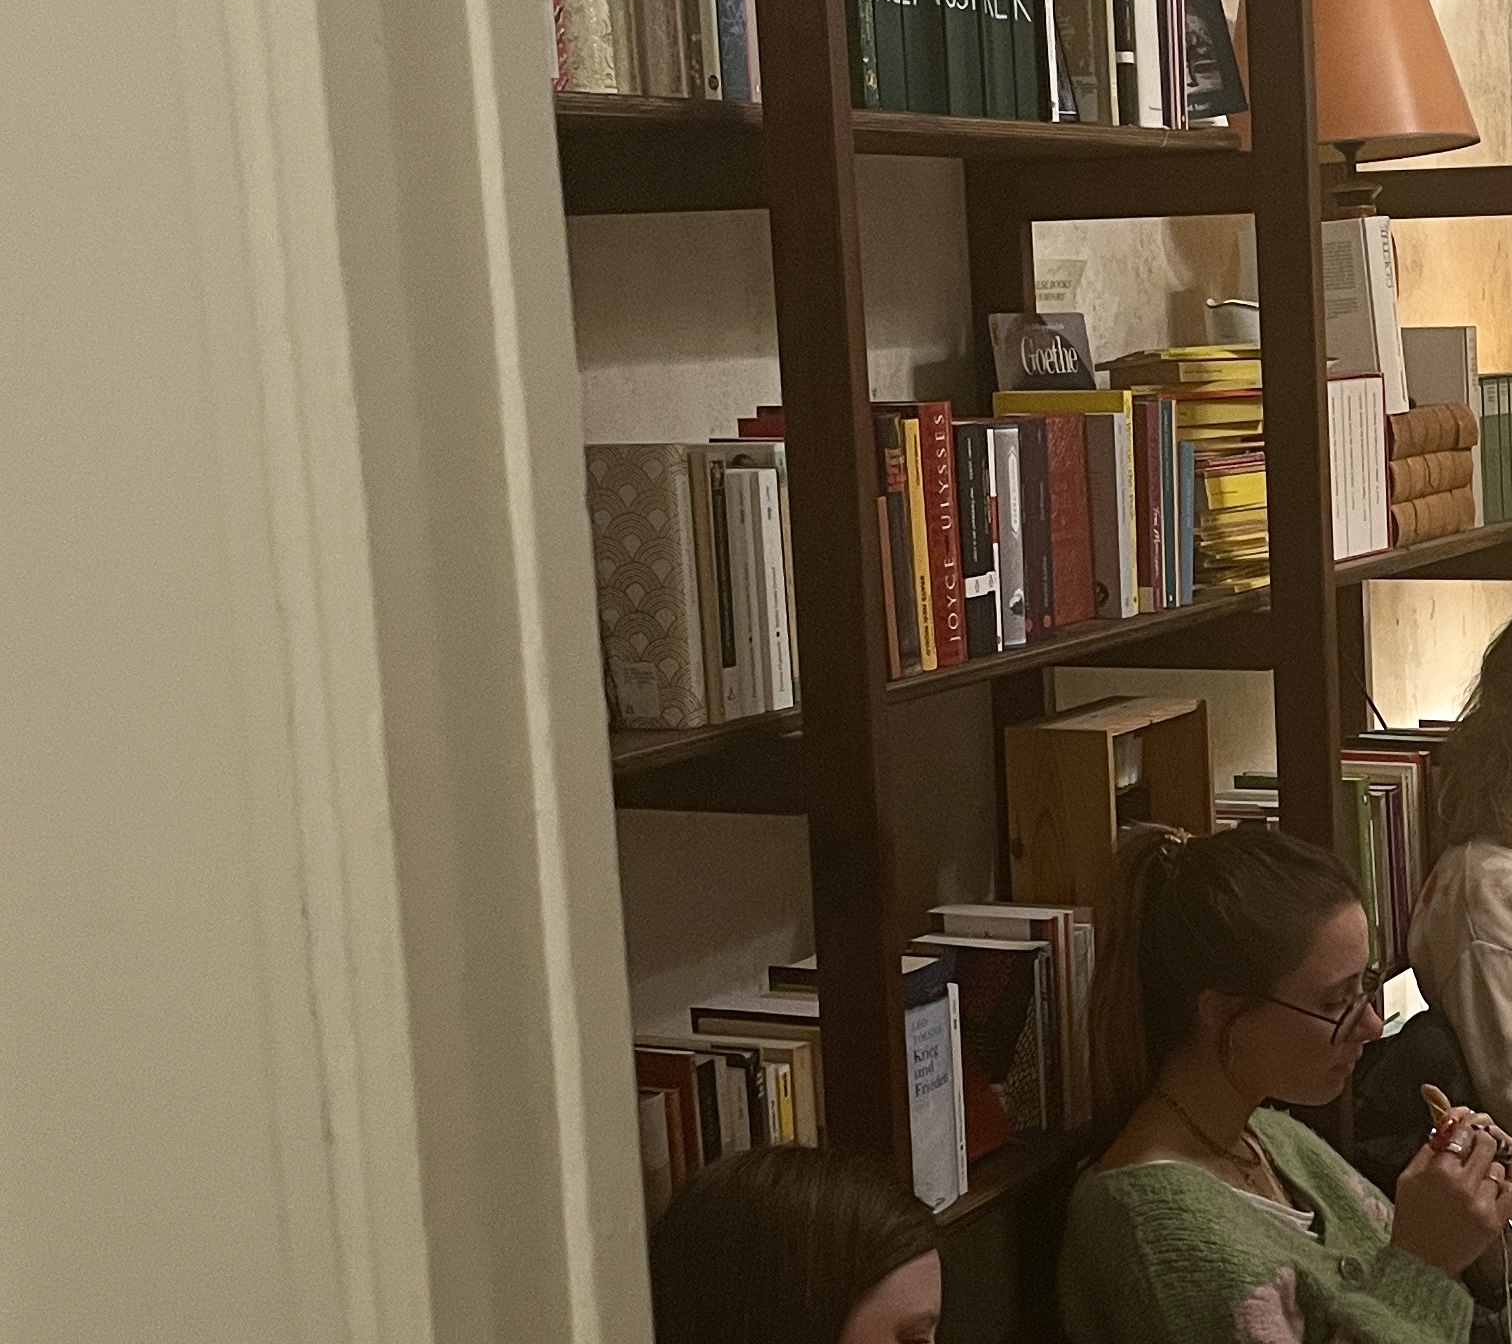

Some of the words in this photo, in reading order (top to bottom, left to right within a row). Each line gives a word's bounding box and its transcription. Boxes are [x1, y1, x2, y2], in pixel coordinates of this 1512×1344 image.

[1021, 335, 1080, 376] Goethe
[934, 414, 952, 530] ULYSSES
[944, 559, 961, 642] JOYCE
[914, 1059, 935, 1080] und
